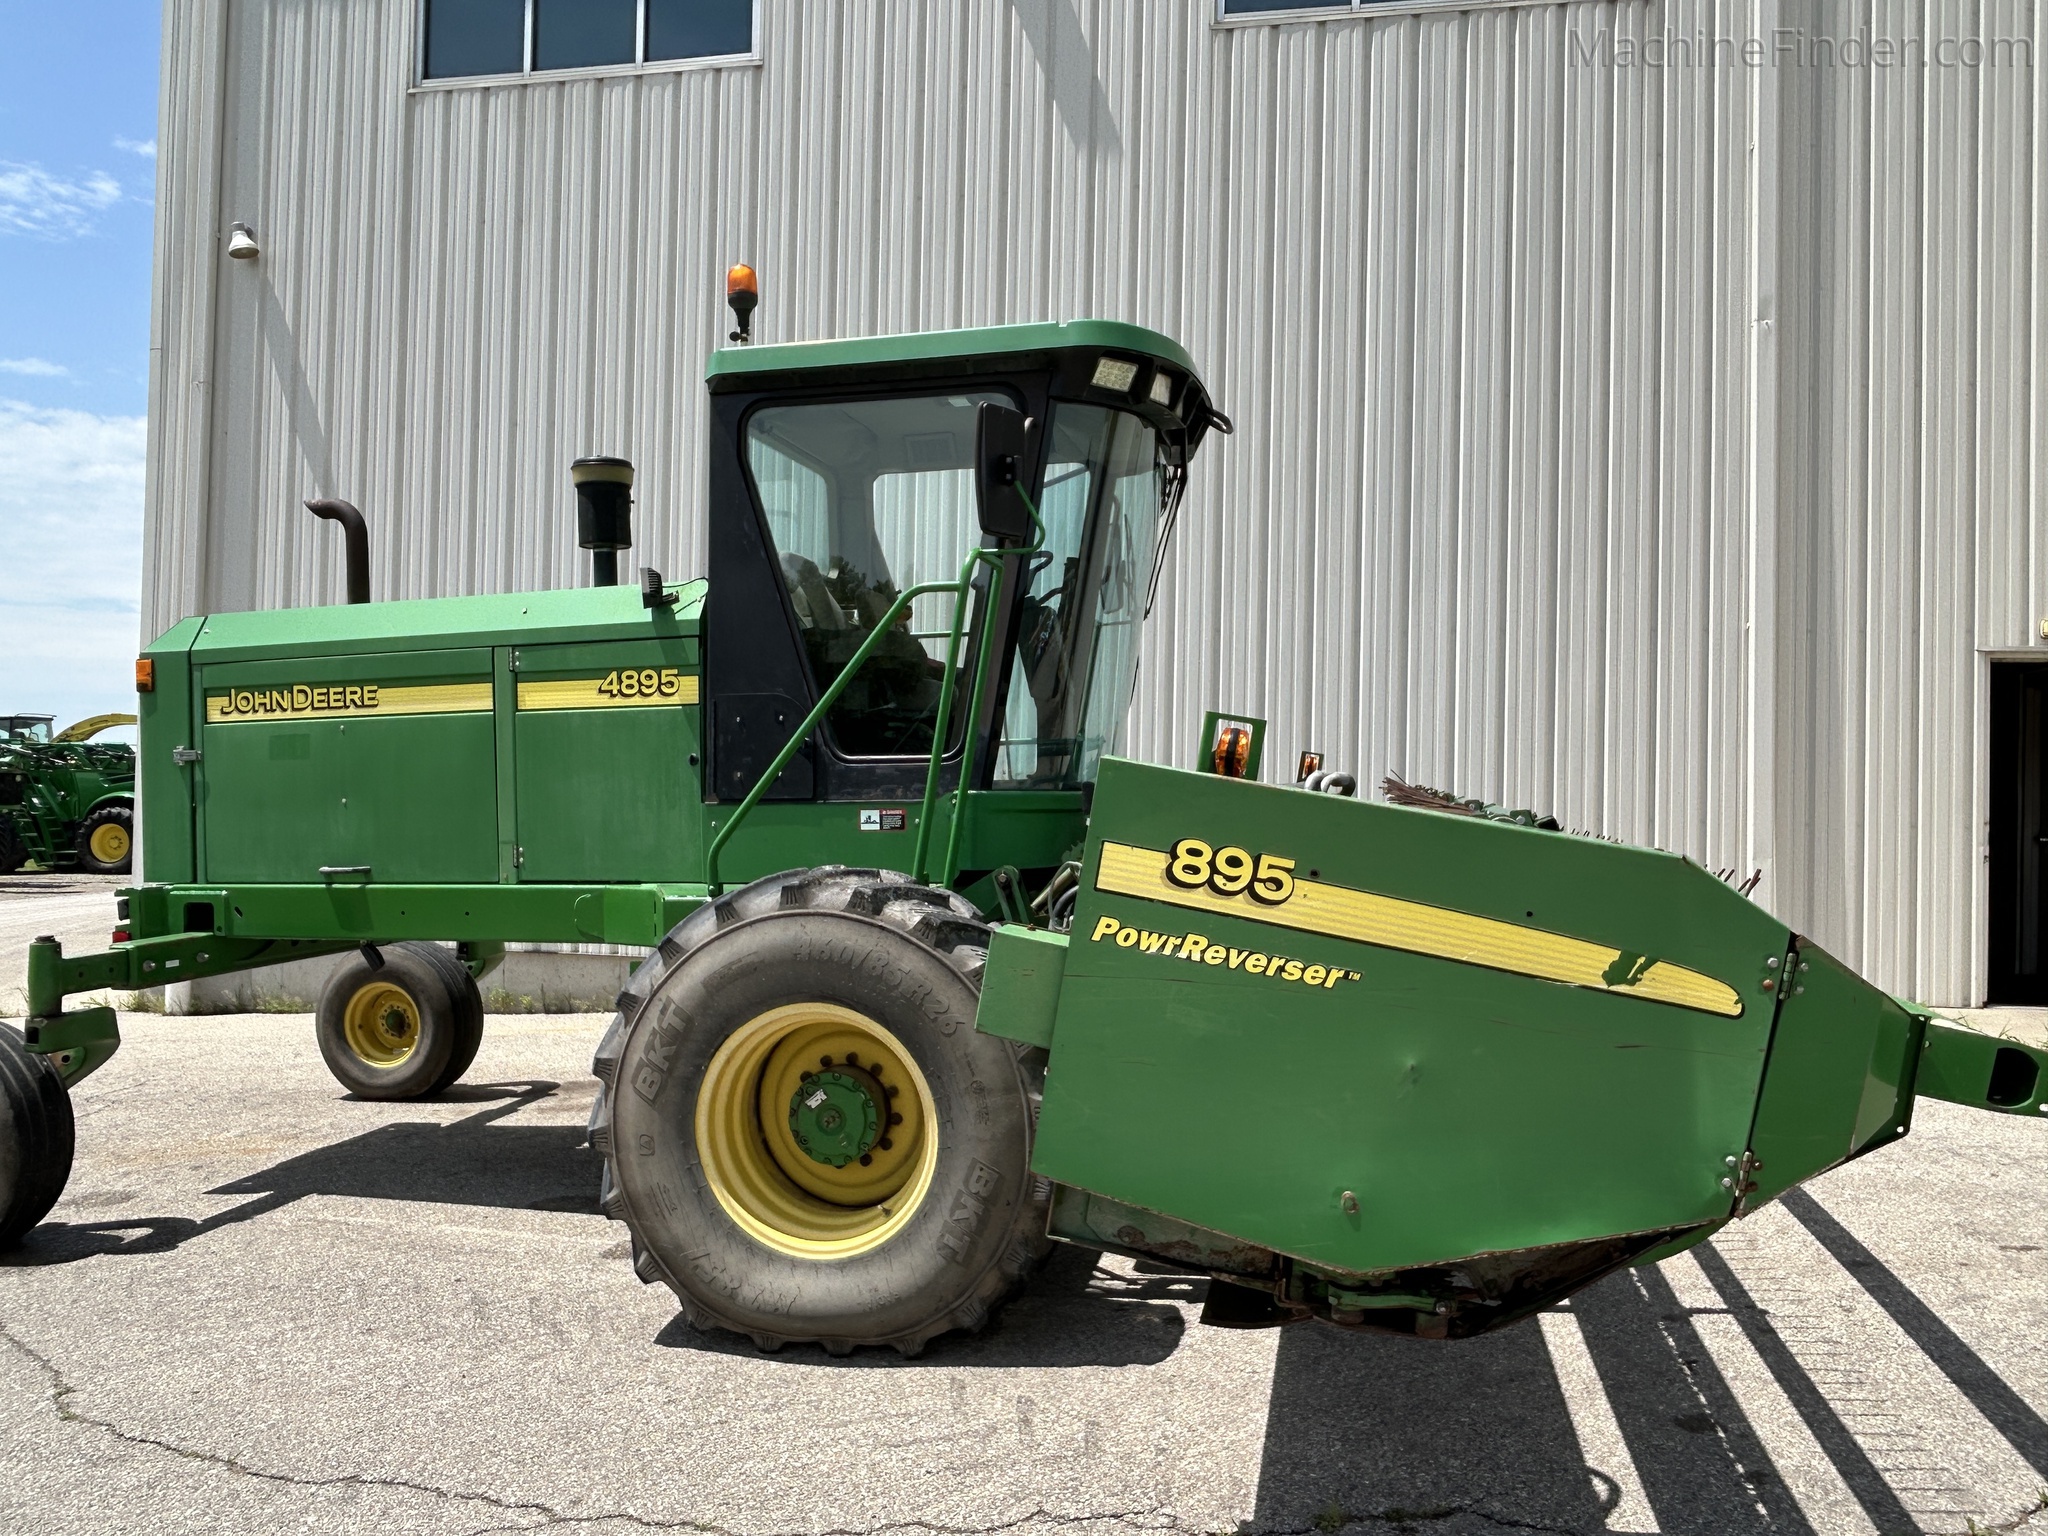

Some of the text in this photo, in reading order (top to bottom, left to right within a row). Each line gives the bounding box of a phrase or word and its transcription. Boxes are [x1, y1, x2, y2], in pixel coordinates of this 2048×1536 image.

[221, 684, 379, 715] JOHN DEERE
[598, 668, 680, 697] 4895
[1165, 837, 1296, 906] 895
[1090, 914, 1345, 990] PowrReverser
[632, 998, 690, 1103] BKT
[940, 1158, 1001, 1264] BKT
